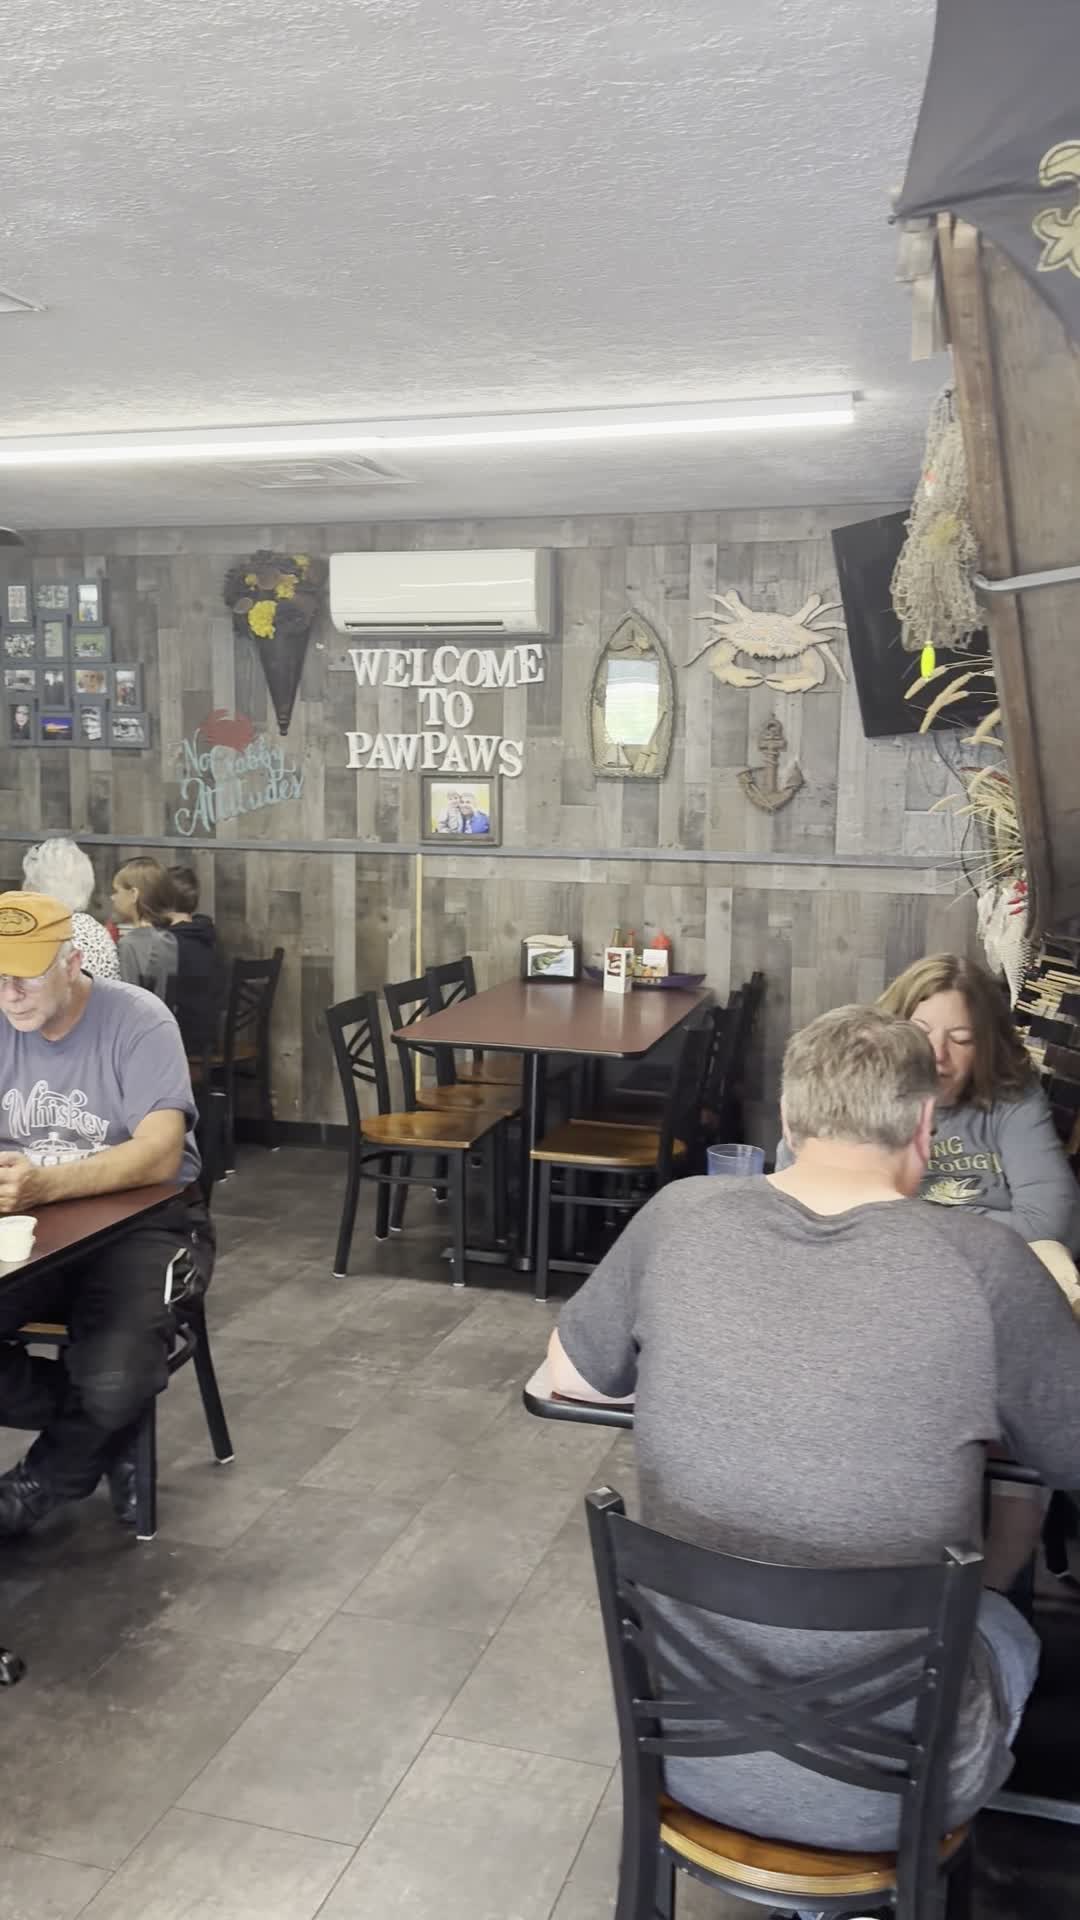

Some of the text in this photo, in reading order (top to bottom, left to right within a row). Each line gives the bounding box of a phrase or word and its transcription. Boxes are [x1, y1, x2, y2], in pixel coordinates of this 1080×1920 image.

[348, 643, 545, 687] WELCOME
[418, 687, 473, 728] TO
[345, 731, 524, 777] PAWPAWS
[2, 1079, 110, 1142] Whiskey
